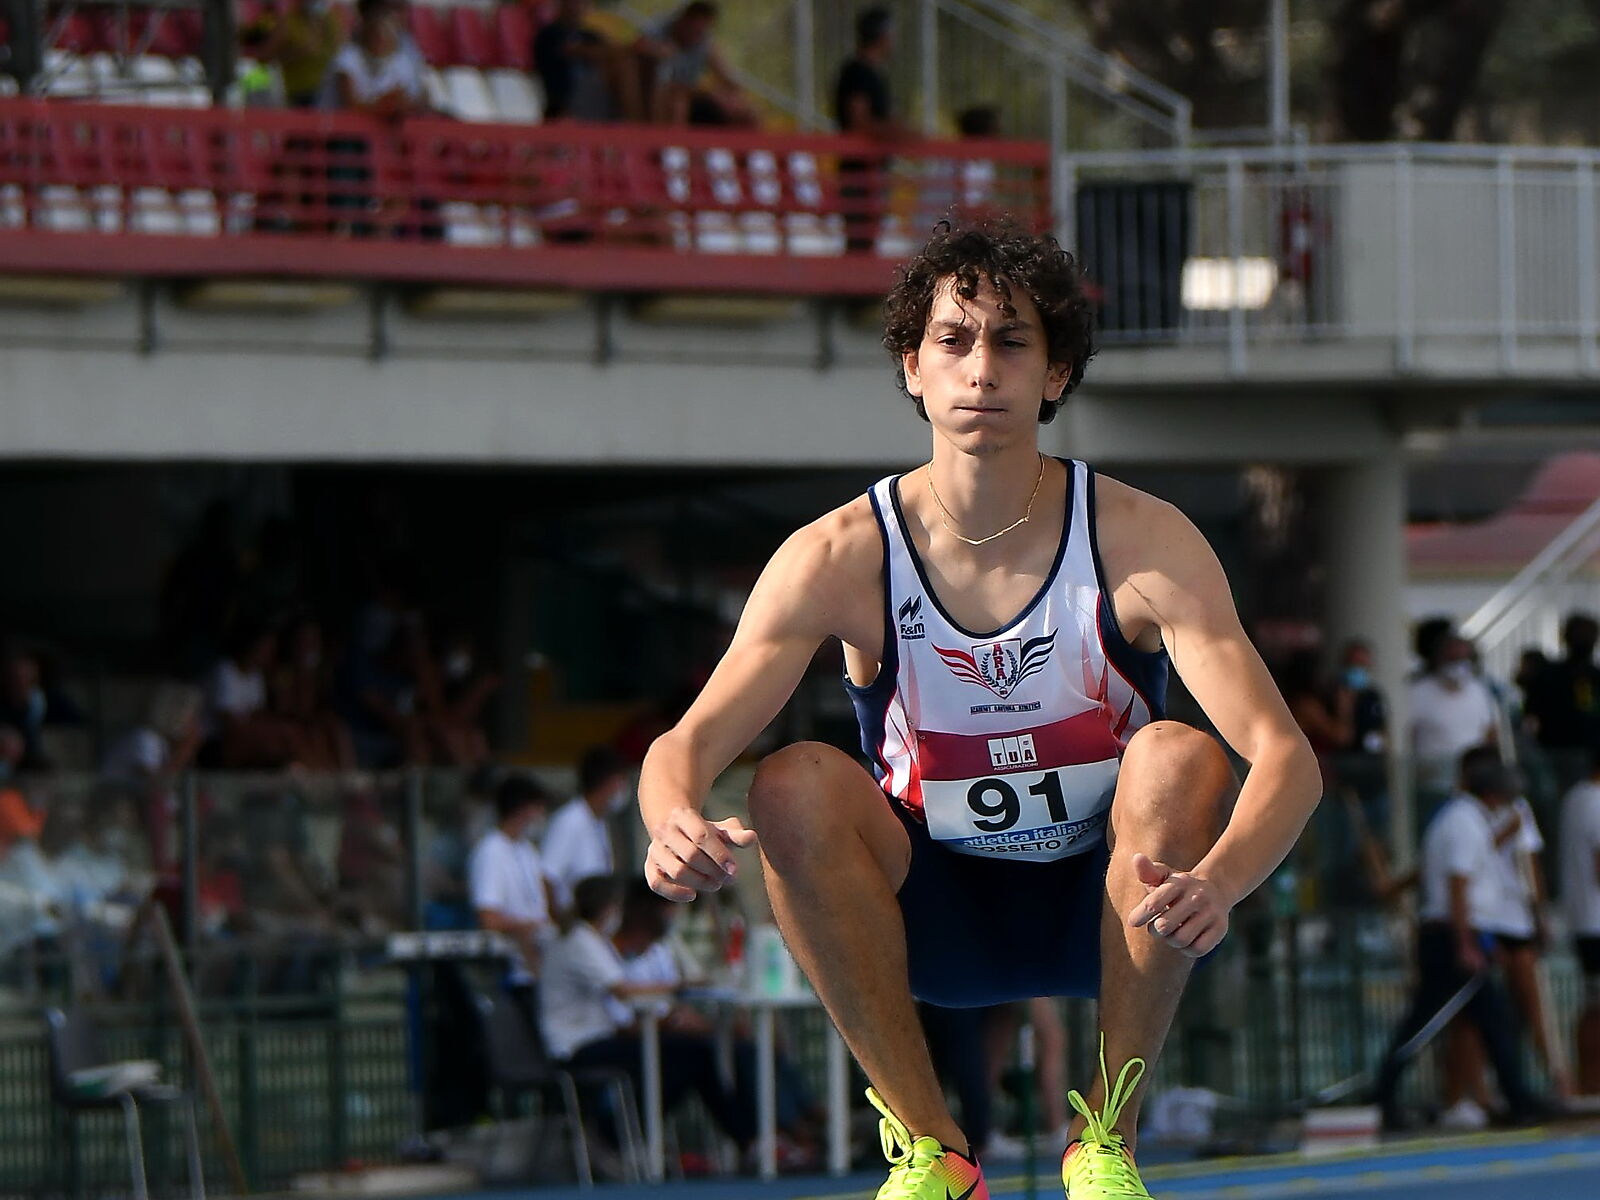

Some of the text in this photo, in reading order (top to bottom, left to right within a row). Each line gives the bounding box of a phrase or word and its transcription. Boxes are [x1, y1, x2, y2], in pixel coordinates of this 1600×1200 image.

[900, 623, 925, 634] F&M
[994, 750, 1035, 764] TUA
[967, 771, 1068, 833] 91
